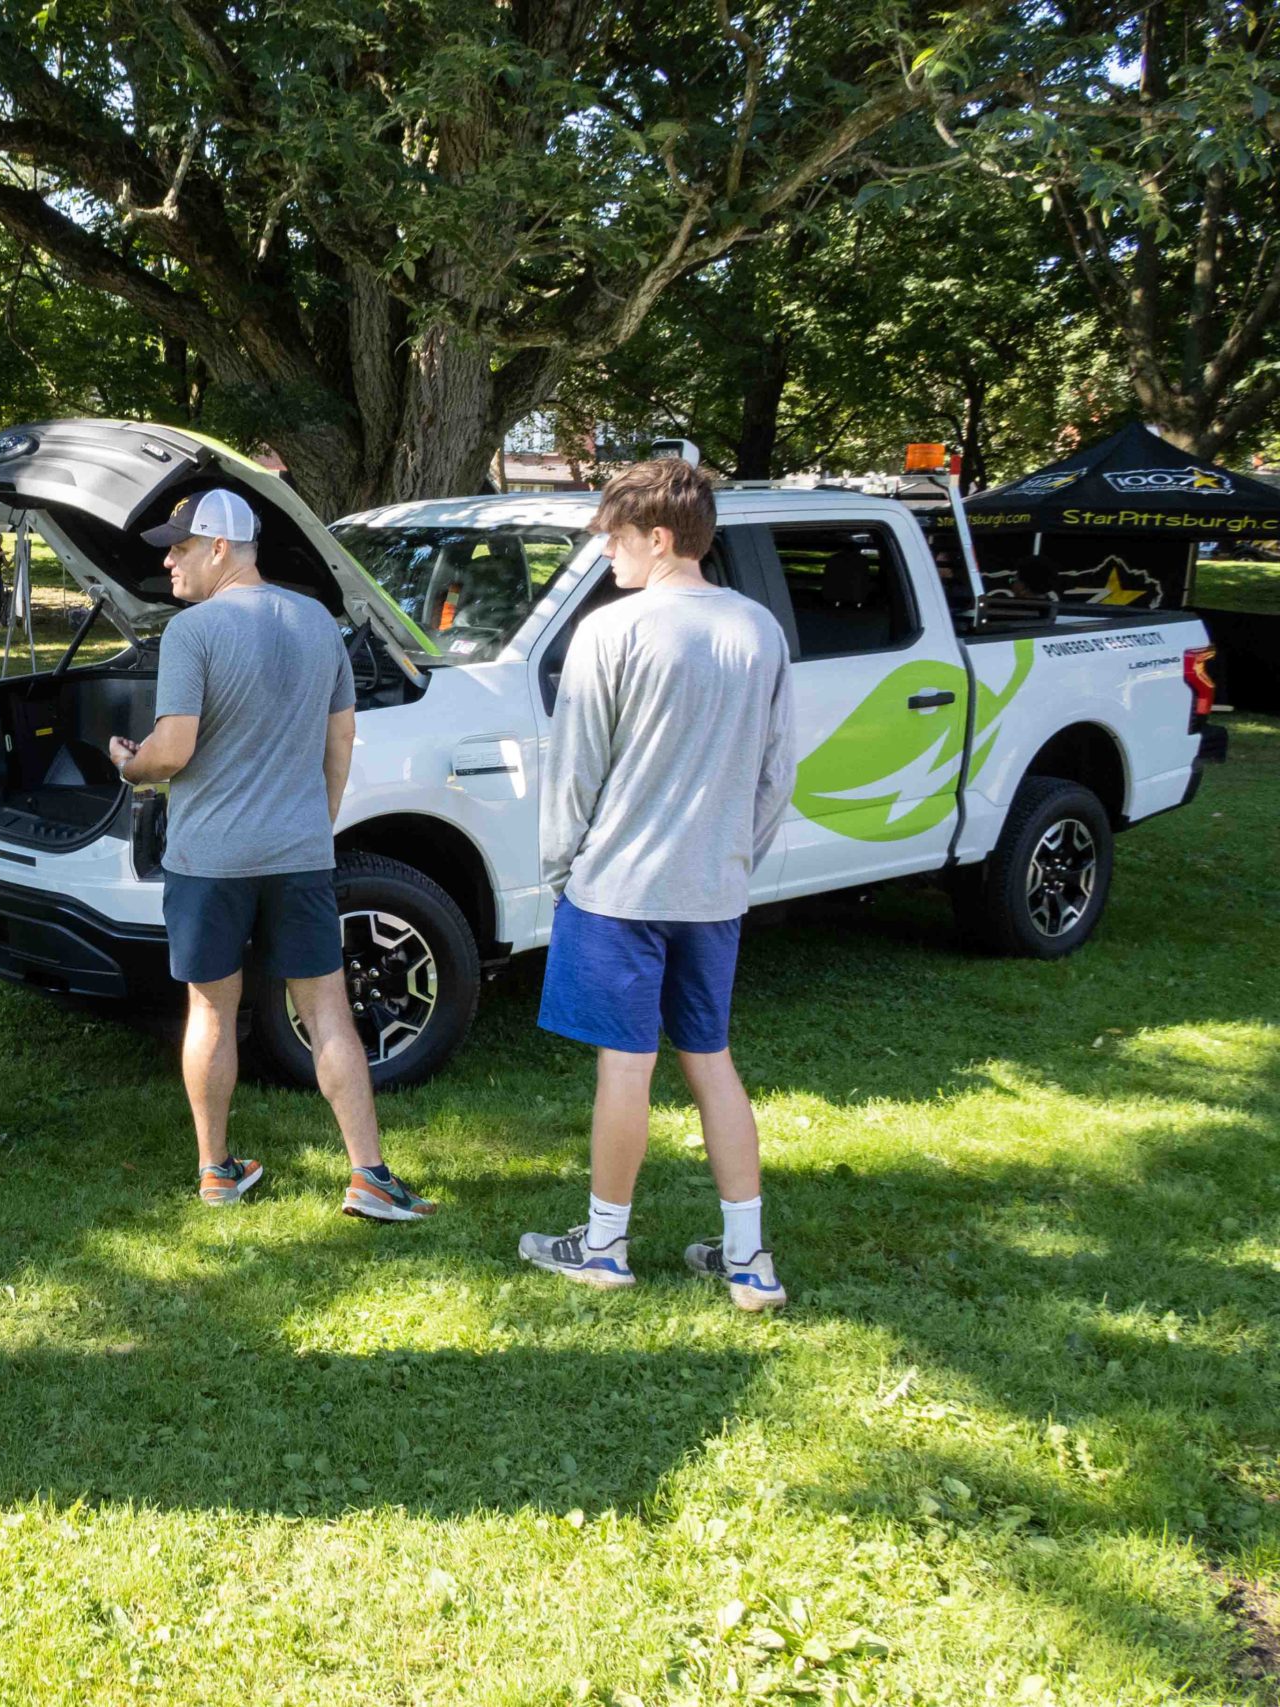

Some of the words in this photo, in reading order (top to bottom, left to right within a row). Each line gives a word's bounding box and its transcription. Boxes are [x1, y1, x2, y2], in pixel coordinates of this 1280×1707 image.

[1042, 640, 1095, 657] POWERED
[1091, 637, 1108, 651] BY
[1106, 632, 1166, 649] ELECTRICITY
